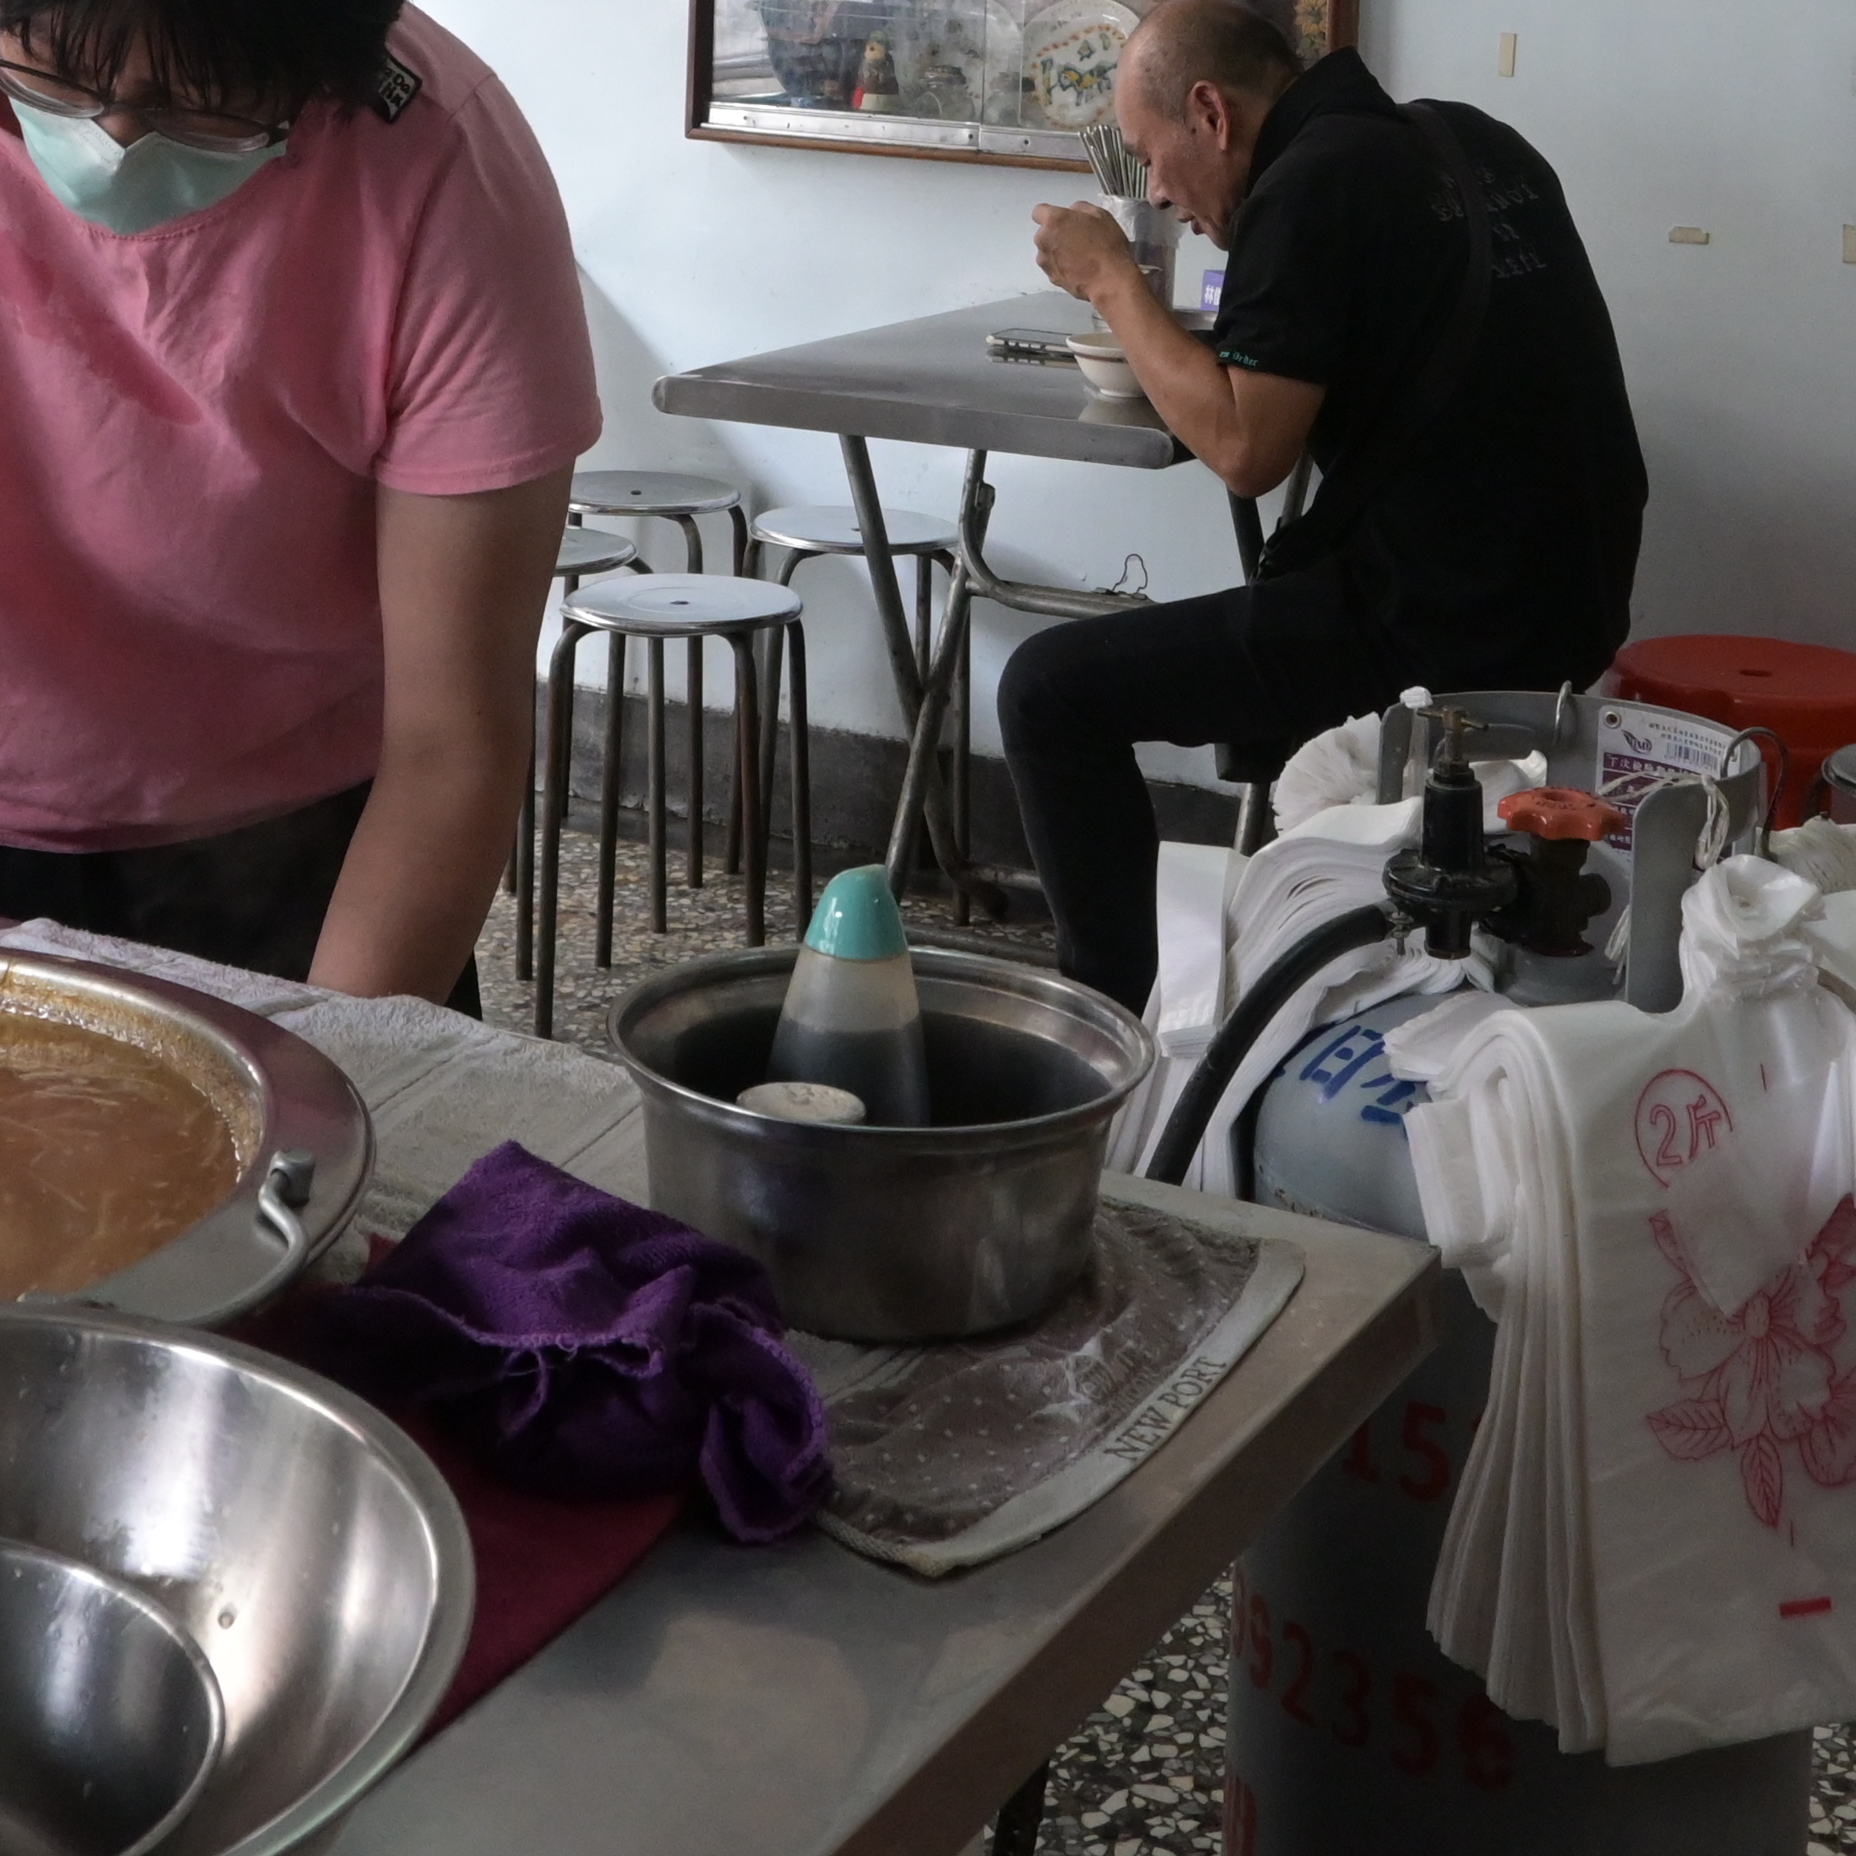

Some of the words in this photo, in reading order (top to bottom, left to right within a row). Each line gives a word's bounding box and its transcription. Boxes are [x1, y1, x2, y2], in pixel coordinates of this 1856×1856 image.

[1649, 1093, 1721, 1167] 2斤
[1103, 1405, 1173, 1461] NEW
[1158, 1356, 1227, 1409] PORT
